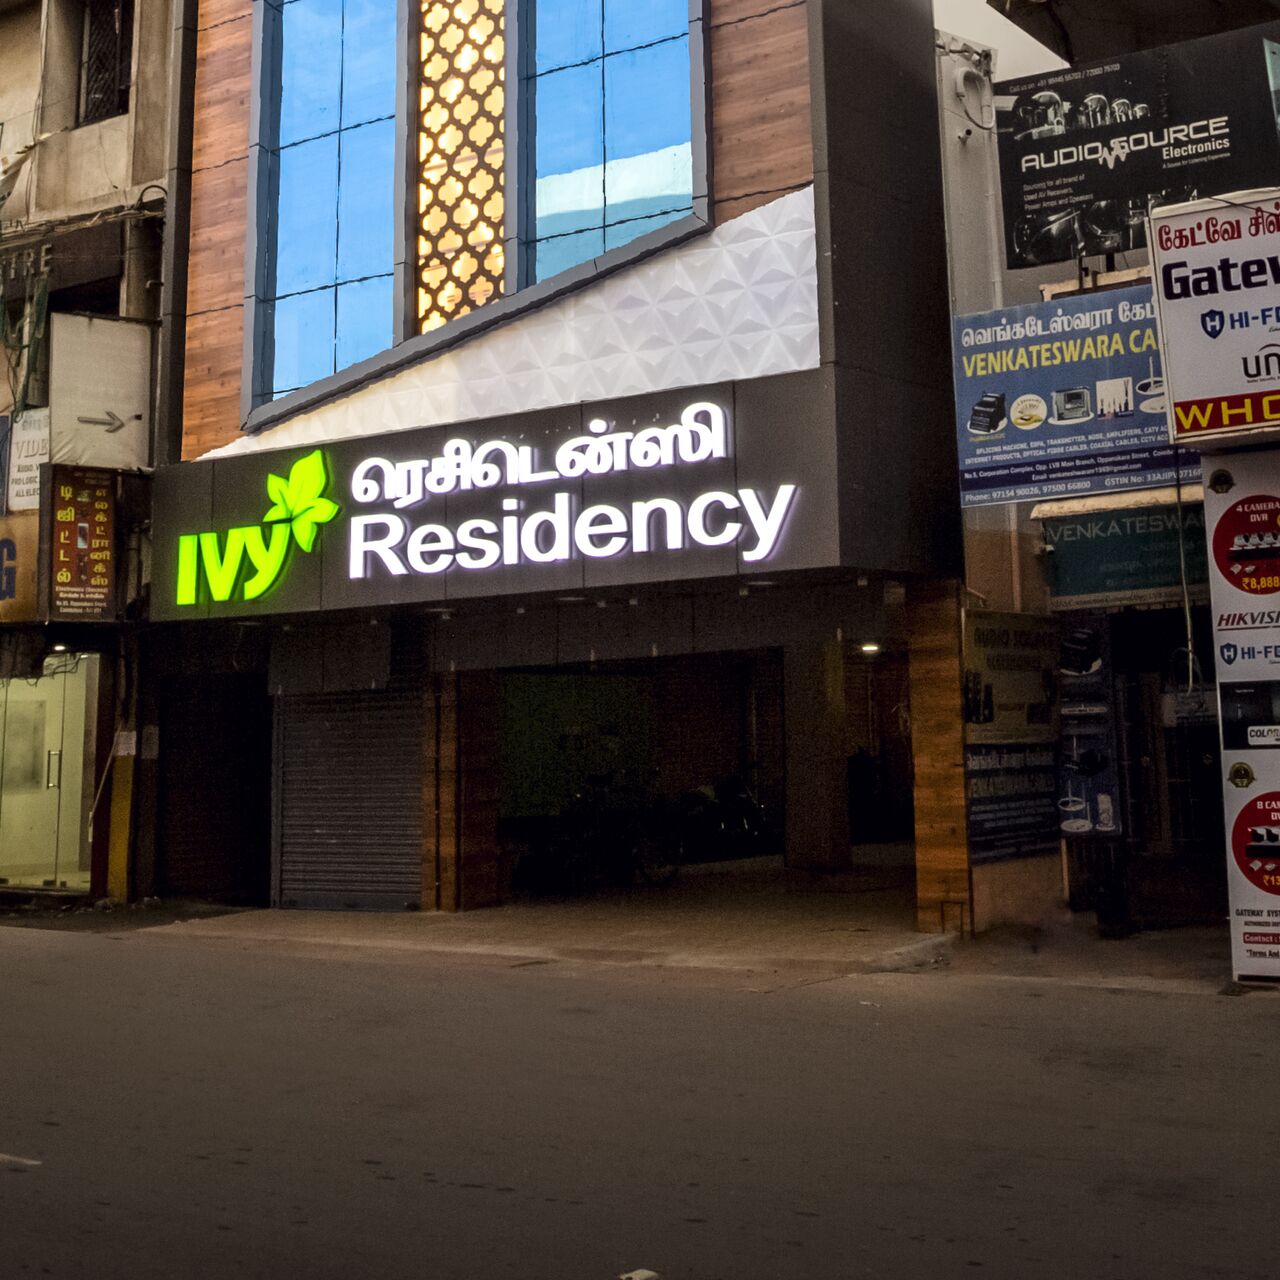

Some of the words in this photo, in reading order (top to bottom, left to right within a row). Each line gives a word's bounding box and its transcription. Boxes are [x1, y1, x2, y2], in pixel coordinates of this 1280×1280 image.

[1162, 138, 1230, 160] Electronics
[963, 333, 1124, 377] VENKATESWARA
[351, 402, 728, 509] ரெசிடென்ஸி
[1244, 502, 1280, 512] CAMERA
[349, 483, 797, 581] Residency
[1049, 512, 1205, 543] VENKATESWA
